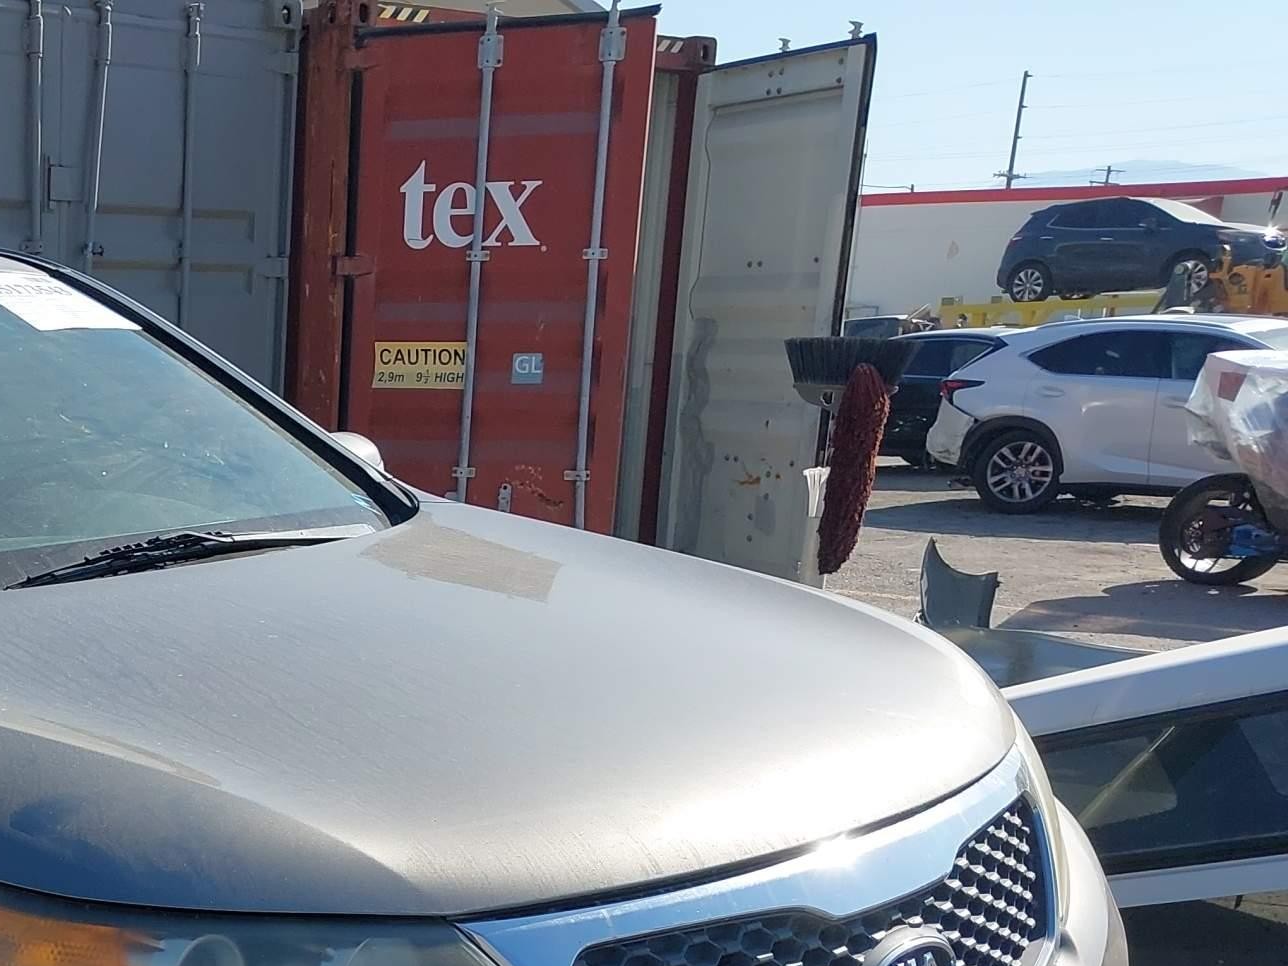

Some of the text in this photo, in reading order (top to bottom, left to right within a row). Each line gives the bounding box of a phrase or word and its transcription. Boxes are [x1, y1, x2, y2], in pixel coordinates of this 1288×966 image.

[399, 159, 543, 250] tex
[379, 348, 465, 366] CAUTION
[514, 356, 543, 374] GL
[378, 371, 405, 383] 2,9m
[434, 372, 464, 383] HIGH
